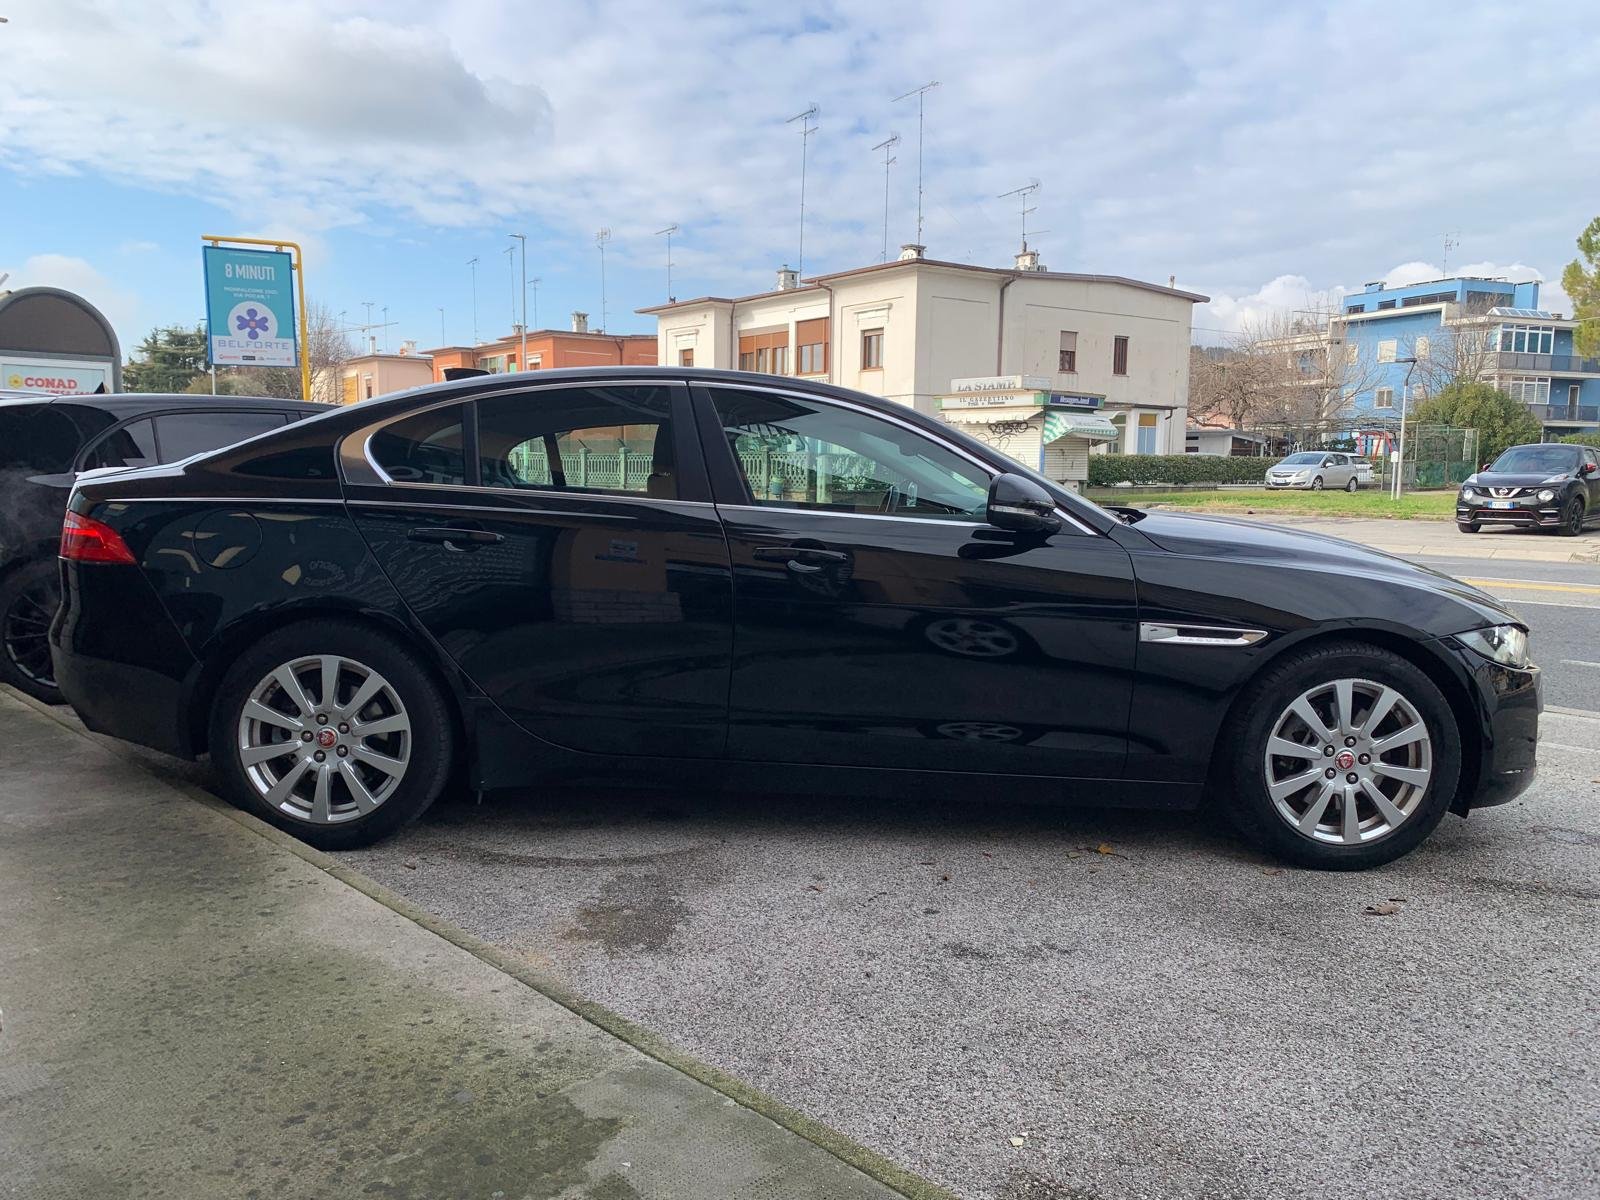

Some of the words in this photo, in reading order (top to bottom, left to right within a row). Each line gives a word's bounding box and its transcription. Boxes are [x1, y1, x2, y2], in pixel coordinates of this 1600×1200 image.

[225, 263, 232, 278] 8
[235, 264, 275, 280] MINUTI
[218, 339, 290, 350] BELFORTE
[24, 377, 78, 389] CONAD
[957, 384, 972, 392] LA
[974, 382, 1016, 391] STAMP
